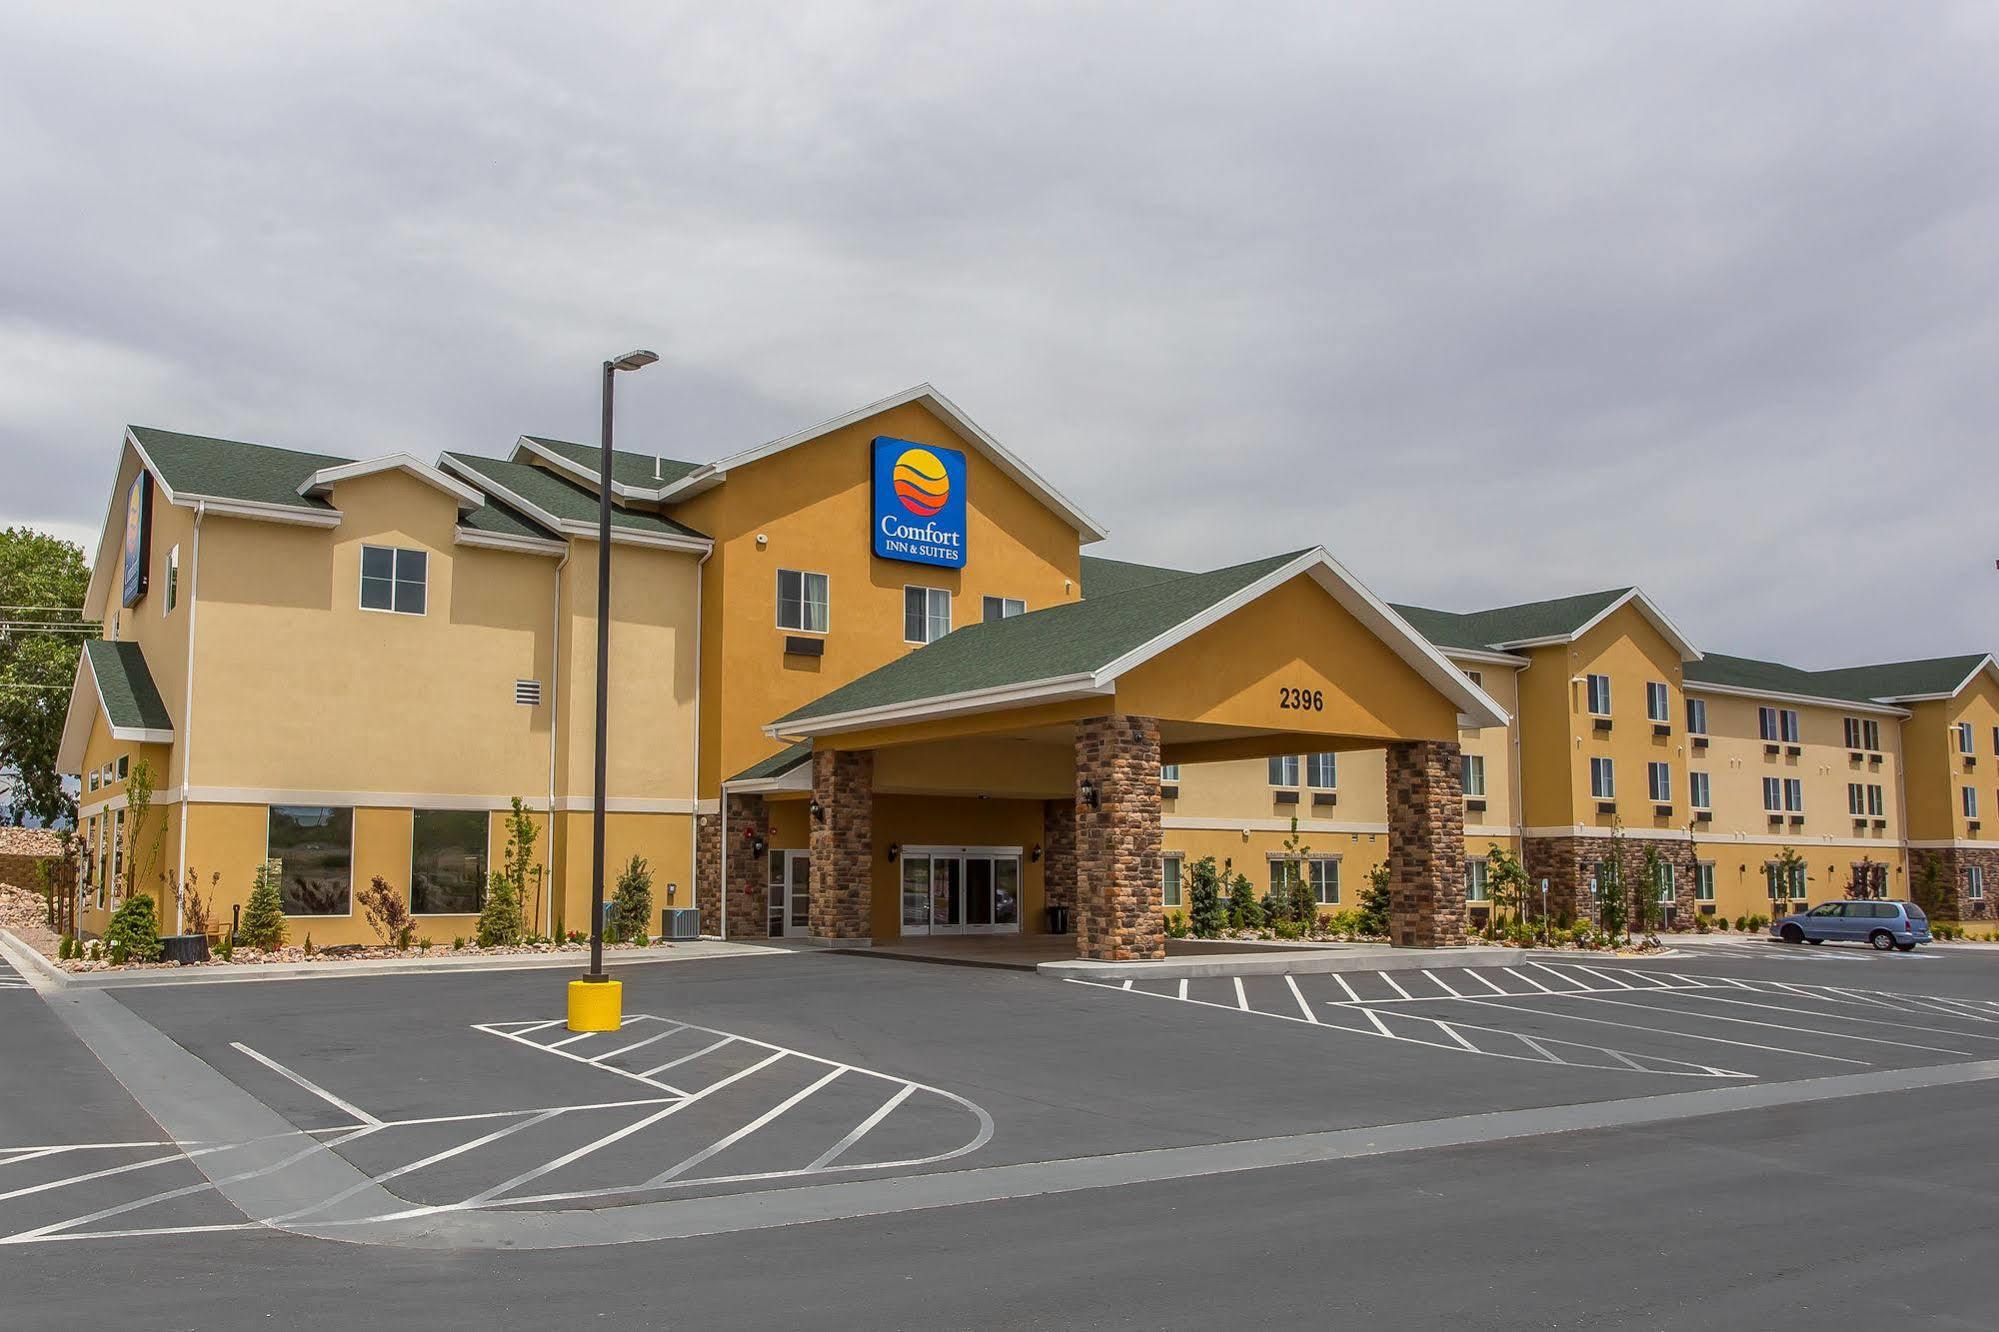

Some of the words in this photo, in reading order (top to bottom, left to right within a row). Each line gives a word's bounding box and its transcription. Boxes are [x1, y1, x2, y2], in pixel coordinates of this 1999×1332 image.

[881, 515, 960, 546] Comfort
[886, 540, 908, 552] INN
[909, 544, 918, 554] &
[919, 545, 959, 560] SUITES
[1280, 687, 1323, 712] 2396
